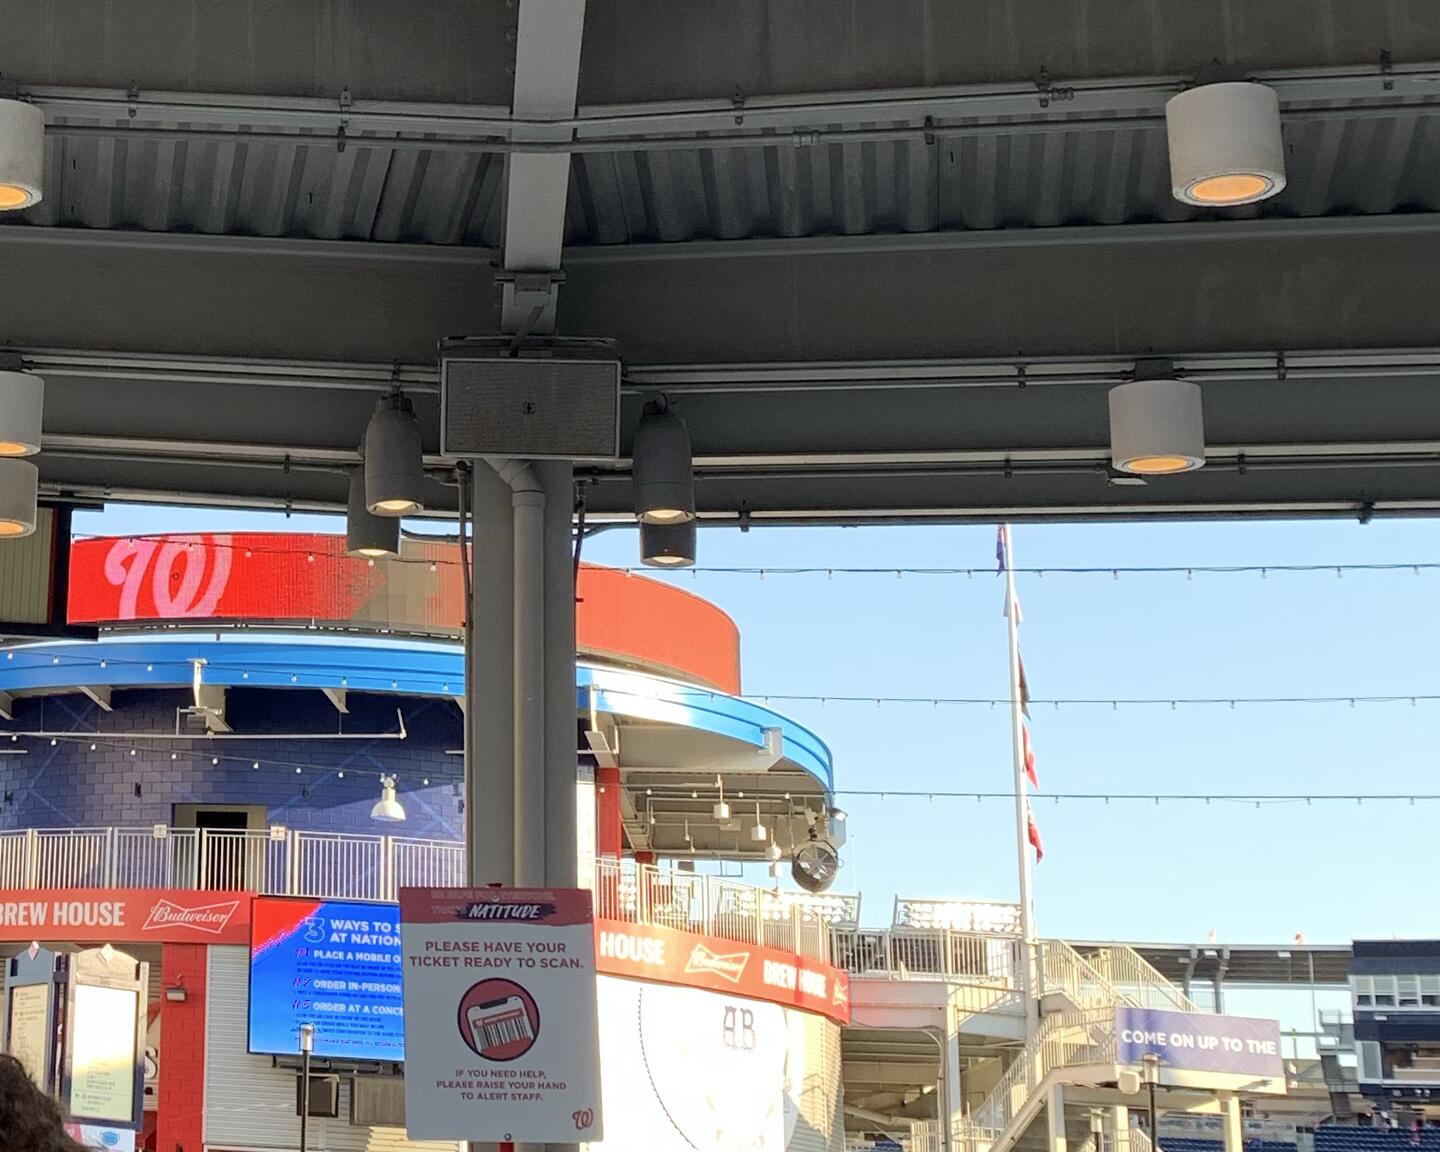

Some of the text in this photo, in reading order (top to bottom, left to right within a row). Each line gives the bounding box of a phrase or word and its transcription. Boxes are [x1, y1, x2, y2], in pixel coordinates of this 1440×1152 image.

[52, 901, 126, 927] HOUSE
[150, 904, 232, 924] Budweiser
[468, 903, 541, 919] NATITUDE
[303, 916, 327, 944] 3
[329, 918, 370, 932] WAYS
[372, 920, 392, 934] TO
[329, 932, 349, 944] AT
[425, 941, 566, 953] PLEASE HAVE YOUR
[599, 930, 666, 966] HOUSE
[313, 949, 345, 961] PLACE
[346, 951, 354, 961] A
[355, 952, 391, 963] MOBILE
[409, 956, 585, 970] TICKET READY TO SCAN.
[763, 959, 798, 990] BREW
[313, 979, 346, 990] ORDER
[348, 981, 401, 993] IN-PERSON
[313, 1002, 346, 1013] ORDER
[348, 1003, 361, 1013] AT
[362, 1004, 370, 1014] A
[1121, 1030, 1278, 1056] COME ON UP TO THE
[455, 1069, 464, 1078] IF
[467, 1069, 488, 1078] YOU
[490, 1070, 517, 1079] NEED
[436, 1080, 567, 1091] PLEASE RAISE YOUR HAND
[461, 1092, 474, 1101] TO
[476, 1092, 508, 1101] ALERT
[572, 1108, 594, 1130] W
